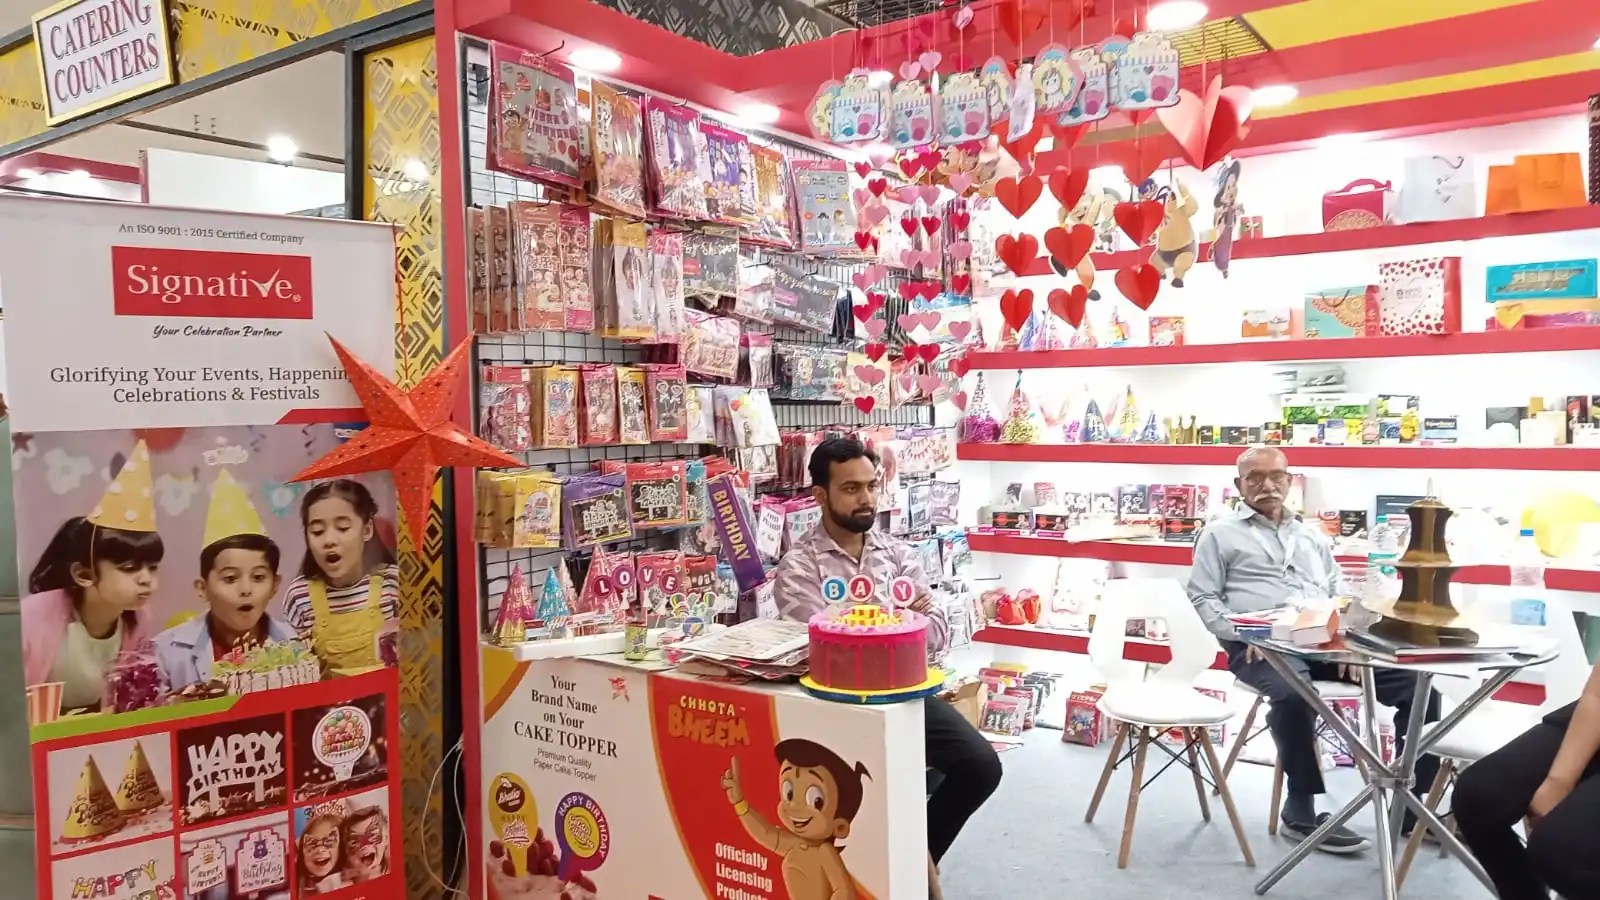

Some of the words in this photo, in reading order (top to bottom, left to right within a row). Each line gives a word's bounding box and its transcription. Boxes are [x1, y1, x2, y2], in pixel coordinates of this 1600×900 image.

[50, 0, 152, 60] CATERING
[54, 33, 160, 103] COUNTERS
[118, 224, 134, 234] An
[136, 224, 155, 235] ISO
[157, 226, 182, 237] 9001
[190, 228, 214, 238] 2015
[216, 229, 258, 241] Certified
[260, 232, 304, 246] Company
[127, 264, 293, 304] Signative
[152, 325, 180, 339] Your
[183, 324, 240, 338] Celebration
[242, 325, 283, 339] Partner
[50, 367, 149, 386] Glorifying
[153, 367, 197, 382] Your
[202, 367, 265, 383] Events,
[268, 366, 351, 385] Happenin
[113, 387, 227, 403] Celebrations
[231, 387, 245, 401] &
[250, 385, 321, 401] Festivals
[712, 490, 752, 560] BIRTHDAY
[551, 675, 577, 692] Your
[531, 689, 563, 708] Brand
[566, 696, 598, 714] Name
[679, 695, 736, 717] CHHOTA
[543, 712, 556, 723] on
[559, 711, 585, 729] Your
[667, 704, 751, 748] BHEEM
[187, 730, 284, 774] HAPPY
[514, 720, 554, 743] CAKE
[557, 729, 618, 759] TOPPER
[533, 758, 553, 771] Paper
[554, 762, 572, 776] Cake
[573, 768, 597, 782] Topper
[537, 747, 567, 762] Premium
[568, 755, 592, 770] Quality
[193, 760, 278, 792] BIRTHDAY
[558, 795, 584, 817] HAPPY
[585, 800, 609, 859] BIRTHDAY
[715, 842, 768, 871] Officially
[71, 859, 157, 899] HAPPY
[715, 862, 773, 893] Licensing
[716, 881, 768, 900] Produc
